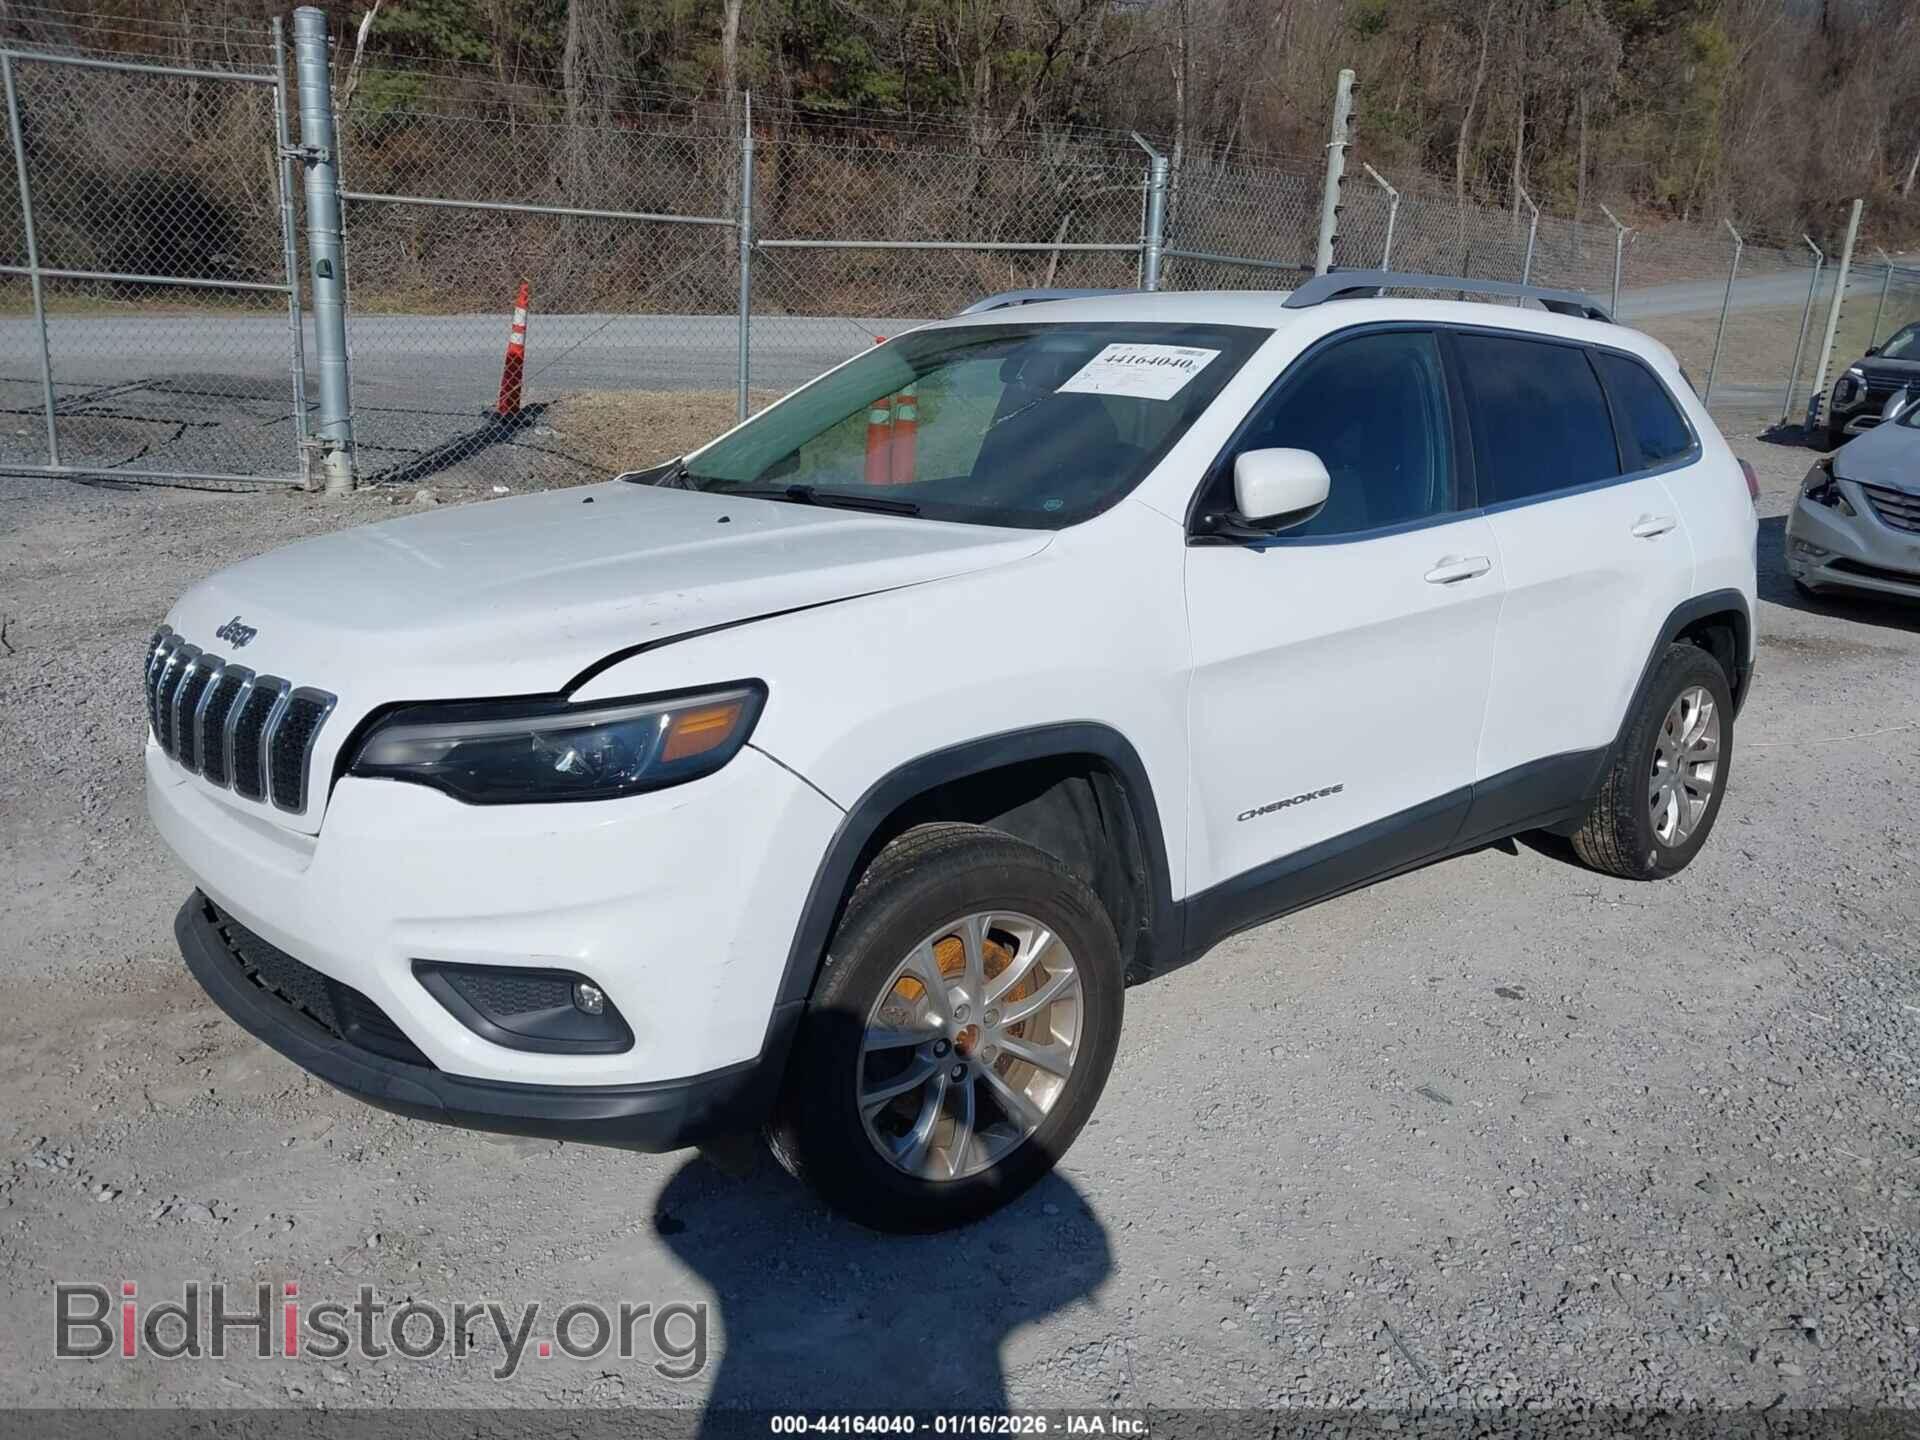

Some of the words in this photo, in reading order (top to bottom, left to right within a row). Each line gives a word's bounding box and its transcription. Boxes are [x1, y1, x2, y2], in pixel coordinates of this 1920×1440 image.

[1104, 354, 1193, 368] 44164040
[216, 615, 258, 650] Jeep
[1237, 783, 1344, 822] CHEROKEE
